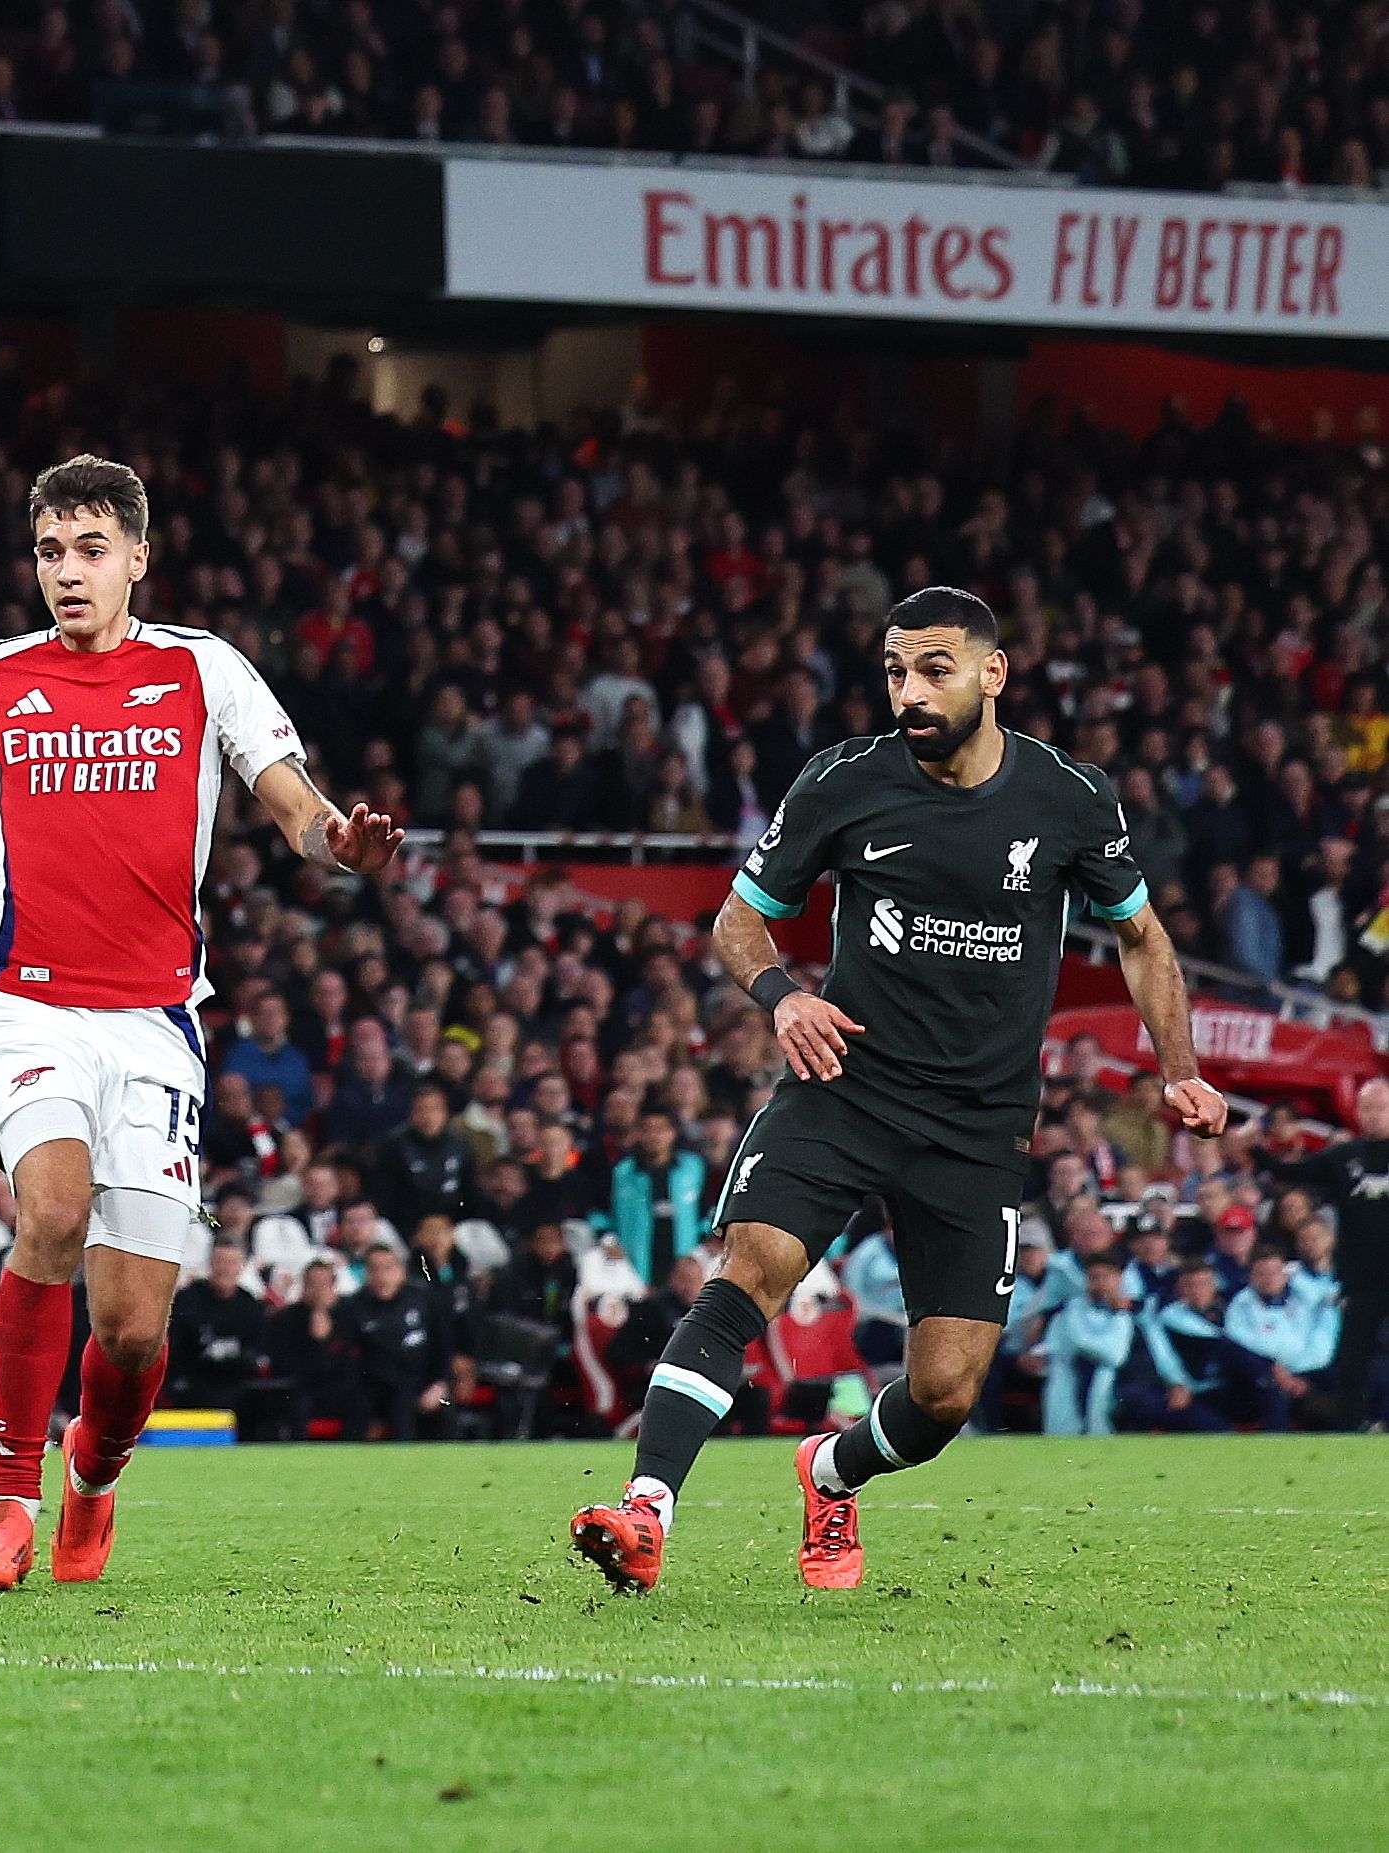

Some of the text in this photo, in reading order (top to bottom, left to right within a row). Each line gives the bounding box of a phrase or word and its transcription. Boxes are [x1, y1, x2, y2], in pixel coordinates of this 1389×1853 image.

[643, 189, 1343, 315] Emirates FLY BETTER
[2, 723, 181, 764] Emirates
[30, 761, 157, 795] FLY BETTER
[911, 914, 1022, 943] standard
[910, 934, 1023, 962] chartered
[1001, 1206, 1021, 1274] 1
